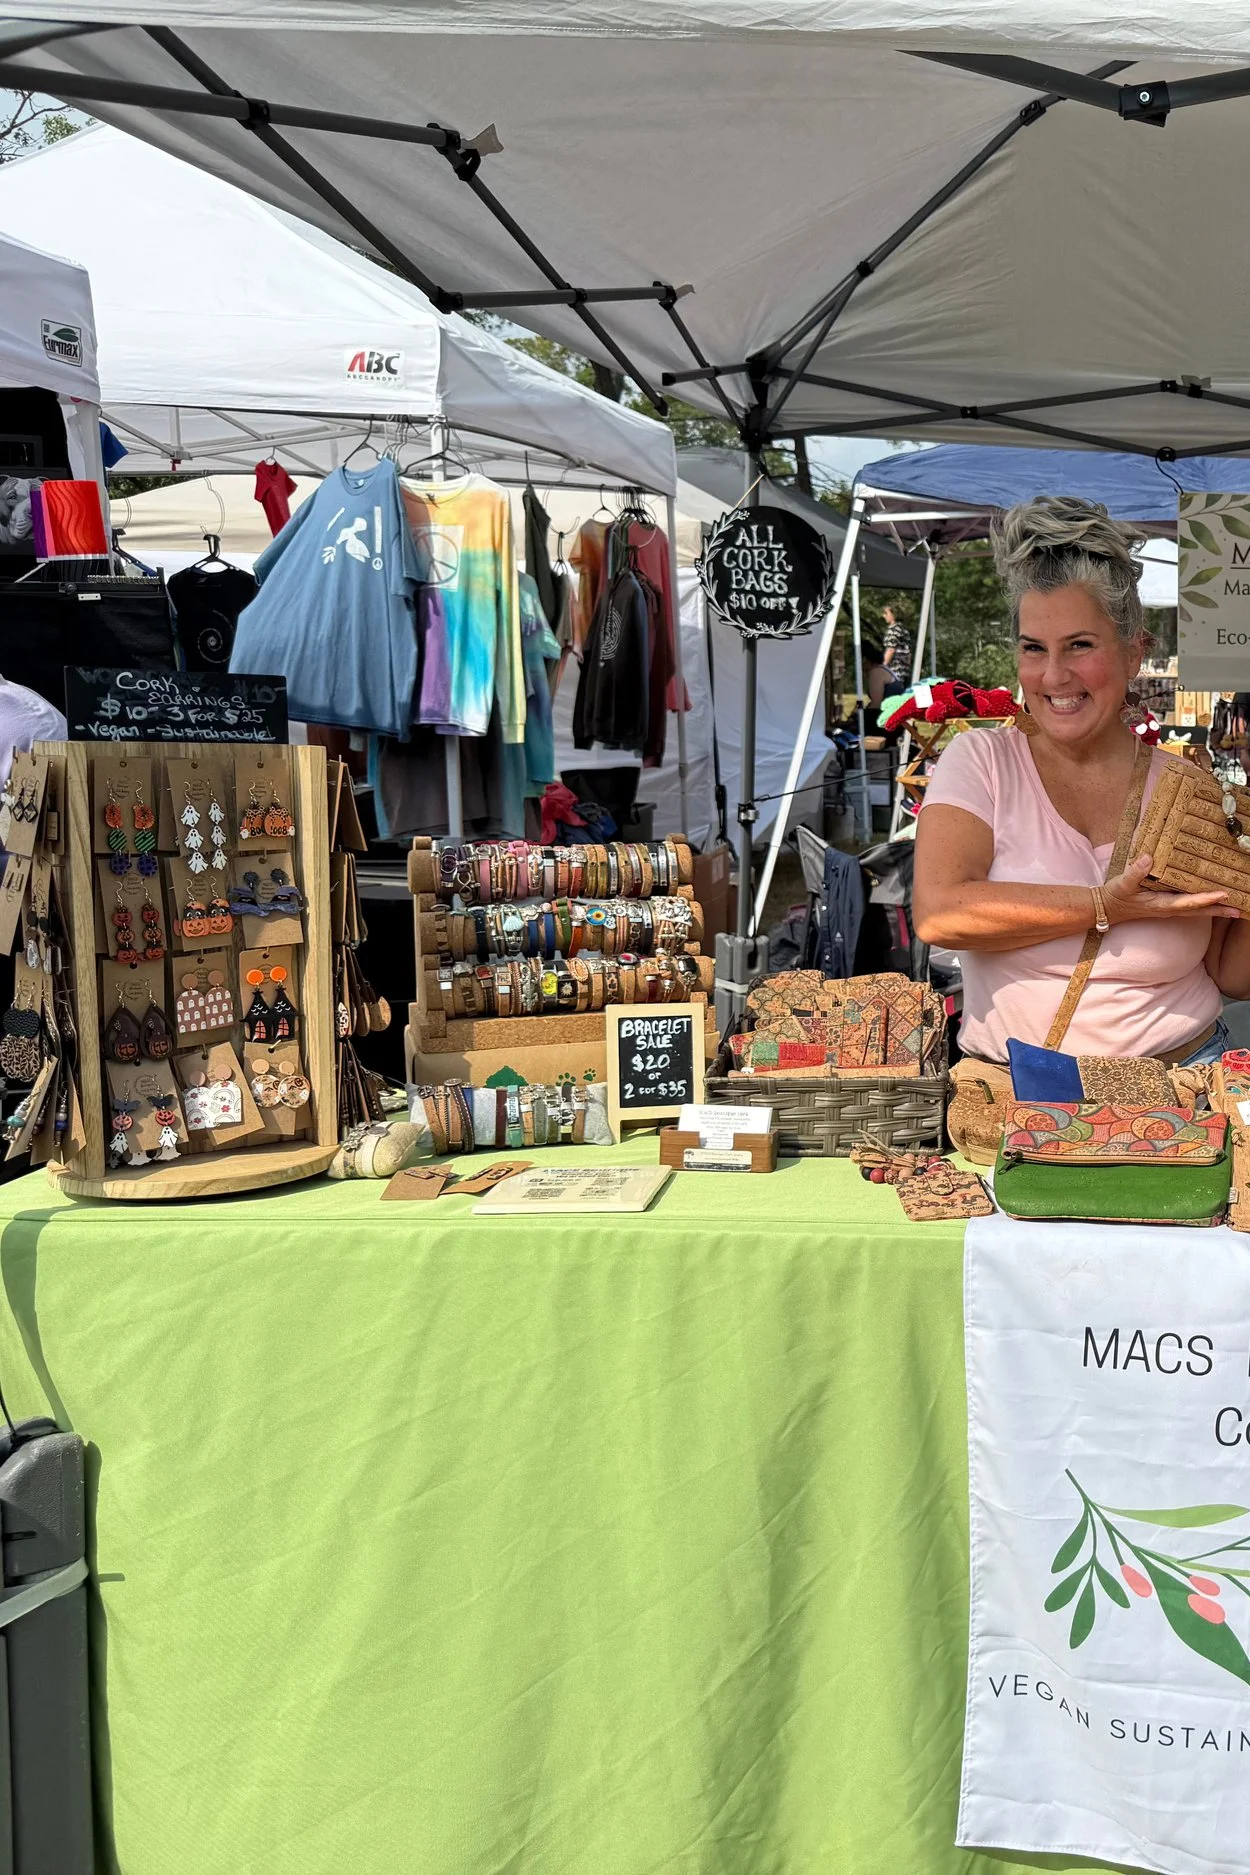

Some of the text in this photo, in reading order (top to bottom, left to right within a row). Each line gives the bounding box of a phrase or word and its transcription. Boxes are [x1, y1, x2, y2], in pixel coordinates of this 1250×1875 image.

[43, 334, 78, 358] Eurmax
[347, 351, 400, 375] ABC
[735, 524, 784, 549] ALL
[723, 547, 793, 572] CORK
[731, 568, 788, 595] BAGS
[729, 592, 757, 610] $10
[116, 671, 180, 693] CORK
[148, 691, 246, 709] EARRINGS
[168, 707, 185, 722] 3
[188, 709, 219, 724] FOR
[621, 1018, 691, 1038] BRACELET
[636, 1034, 673, 1050] SALE
[632, 1053, 671, 1072] $20
[624, 1083, 636, 1100] 2
[657, 1080, 688, 1098] $35
[1083, 1326, 1214, 1377] MACS
[988, 1674, 1090, 1730] VEGAN
